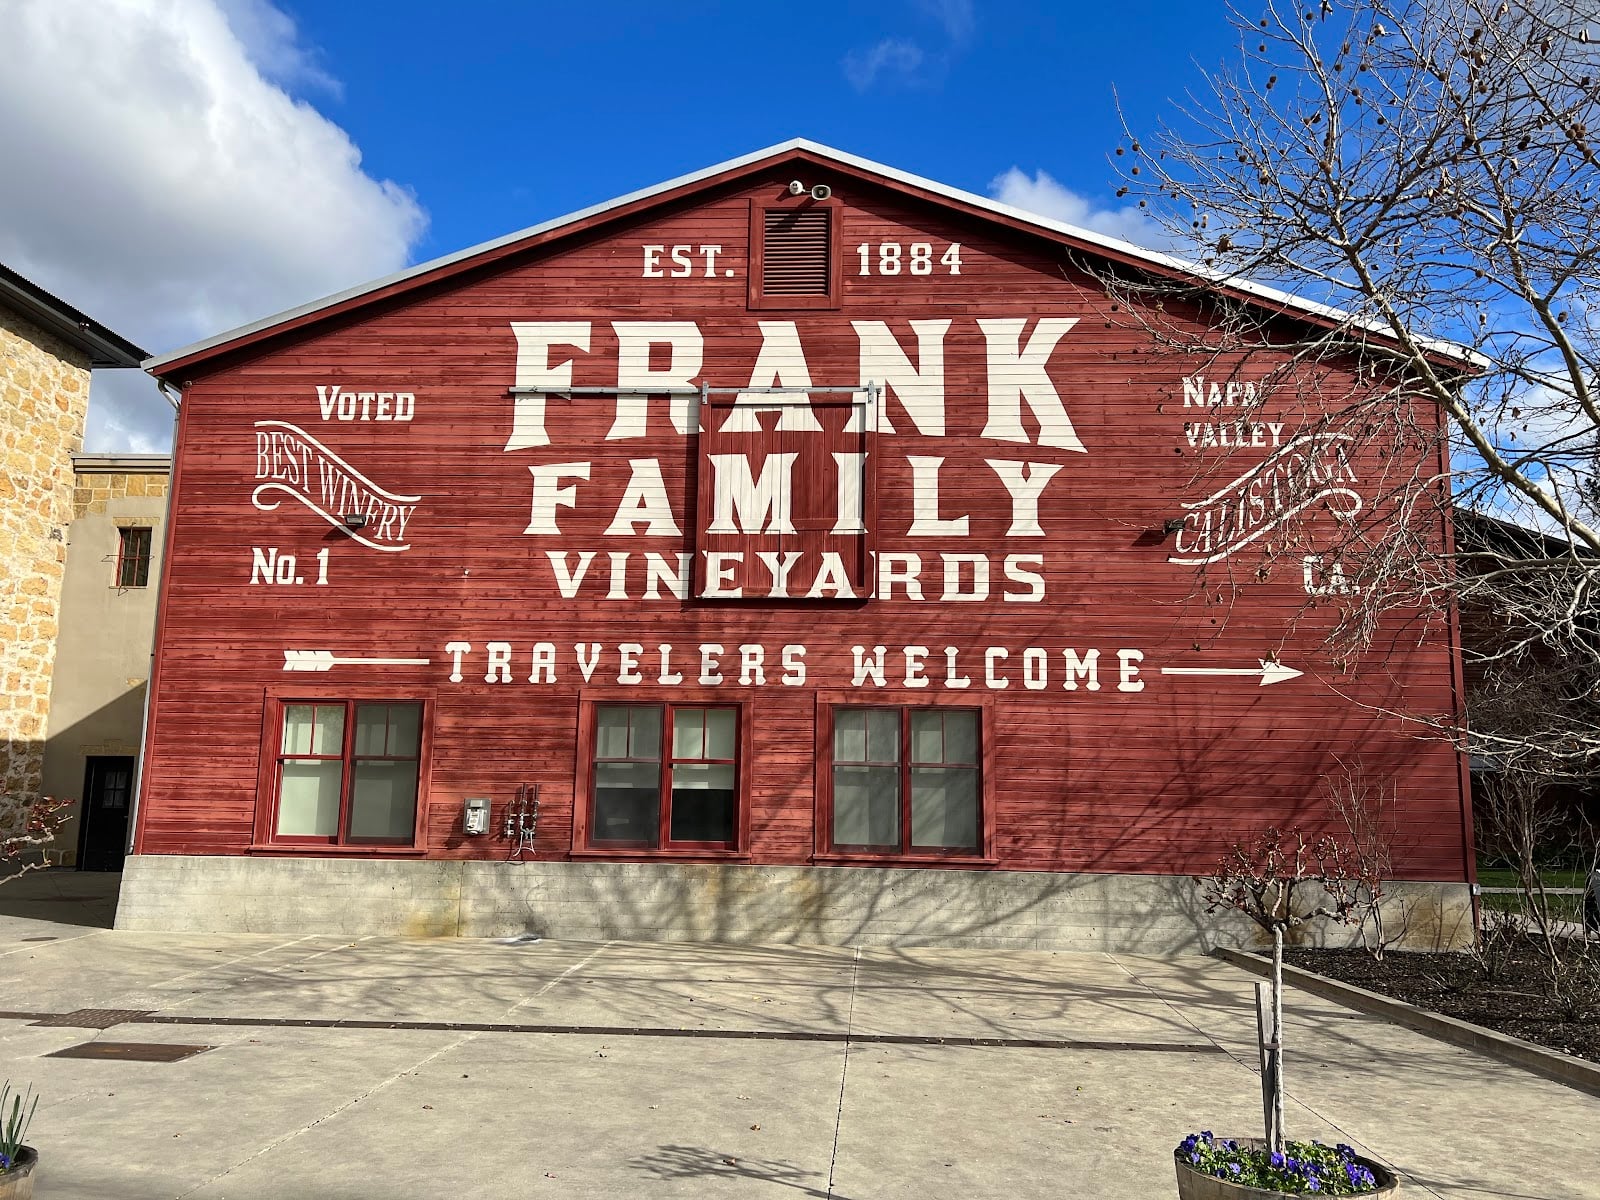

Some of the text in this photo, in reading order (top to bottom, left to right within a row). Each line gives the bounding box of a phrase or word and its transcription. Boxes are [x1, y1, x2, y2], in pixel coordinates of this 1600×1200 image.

[641, 242, 963, 278] EST. 1884
[504, 319, 1088, 453] FRANK
[1182, 421, 1285, 448] VALLEY
[254, 431, 417, 541] BEST WINERY
[522, 454, 1064, 537] FAMILY
[1174, 443, 1359, 553] CALISTOGA
[315, 547, 330, 585] 1
[545, 550, 1046, 602] VINEYARDS
[444, 641, 1146, 693] TRAVELERS WELCOME
